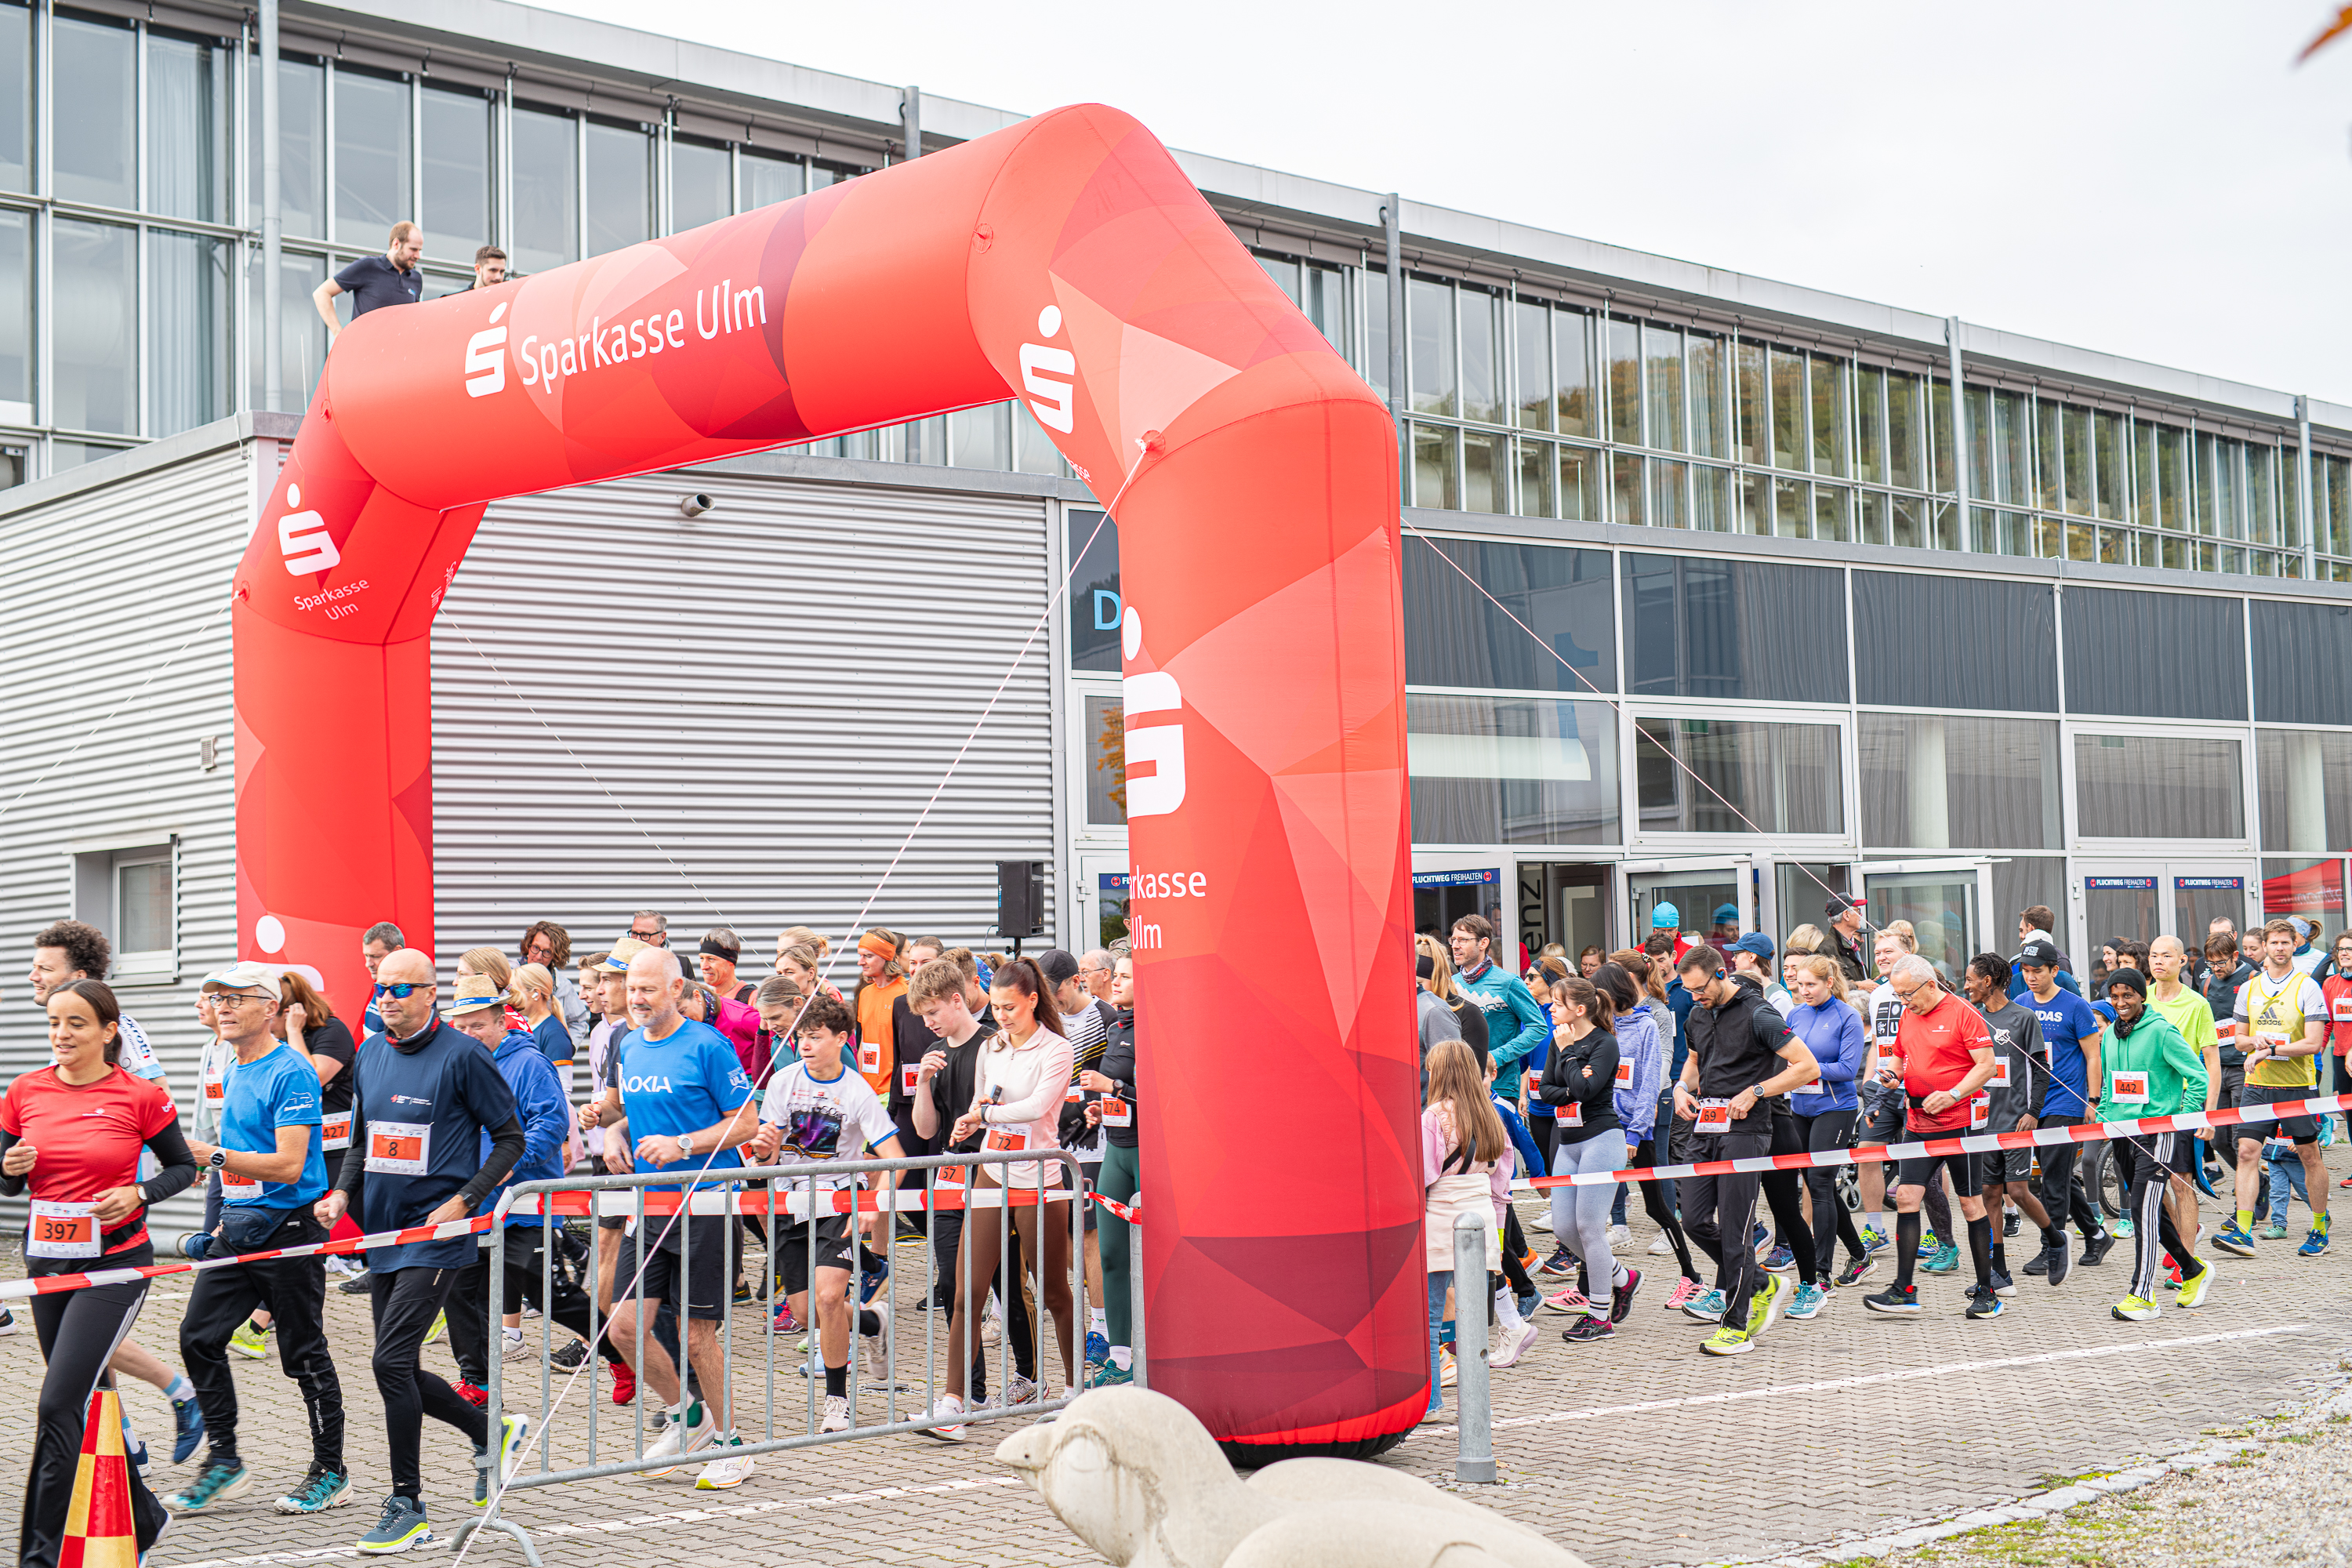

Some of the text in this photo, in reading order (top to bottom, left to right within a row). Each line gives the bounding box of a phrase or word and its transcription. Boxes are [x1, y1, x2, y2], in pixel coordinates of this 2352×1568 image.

[521, 278, 767, 394] Sparkasse Ulm
[293, 579, 369, 612] Sparkasse
[325, 603, 359, 620] Ulm
[1412, 874, 1450, 884] FLUCHTWEG
[1450, 872, 1483, 882] FREIHALTEN
[1131, 915, 1162, 949] Ulm
[2219, 1029, 2230, 1037] 89
[2120, 1083, 2137, 1094] 442
[1104, 1102, 1120, 1114] 274
[1562, 1106, 1570, 1116] 97
[1704, 1110, 1716, 1122] 69
[322, 1126, 344, 1139] 427
[388, 1142, 398, 1156] 8
[997, 1137, 1011, 1151] 72
[942, 1167, 956, 1180] 57
[44, 1222, 78, 1240] 397
